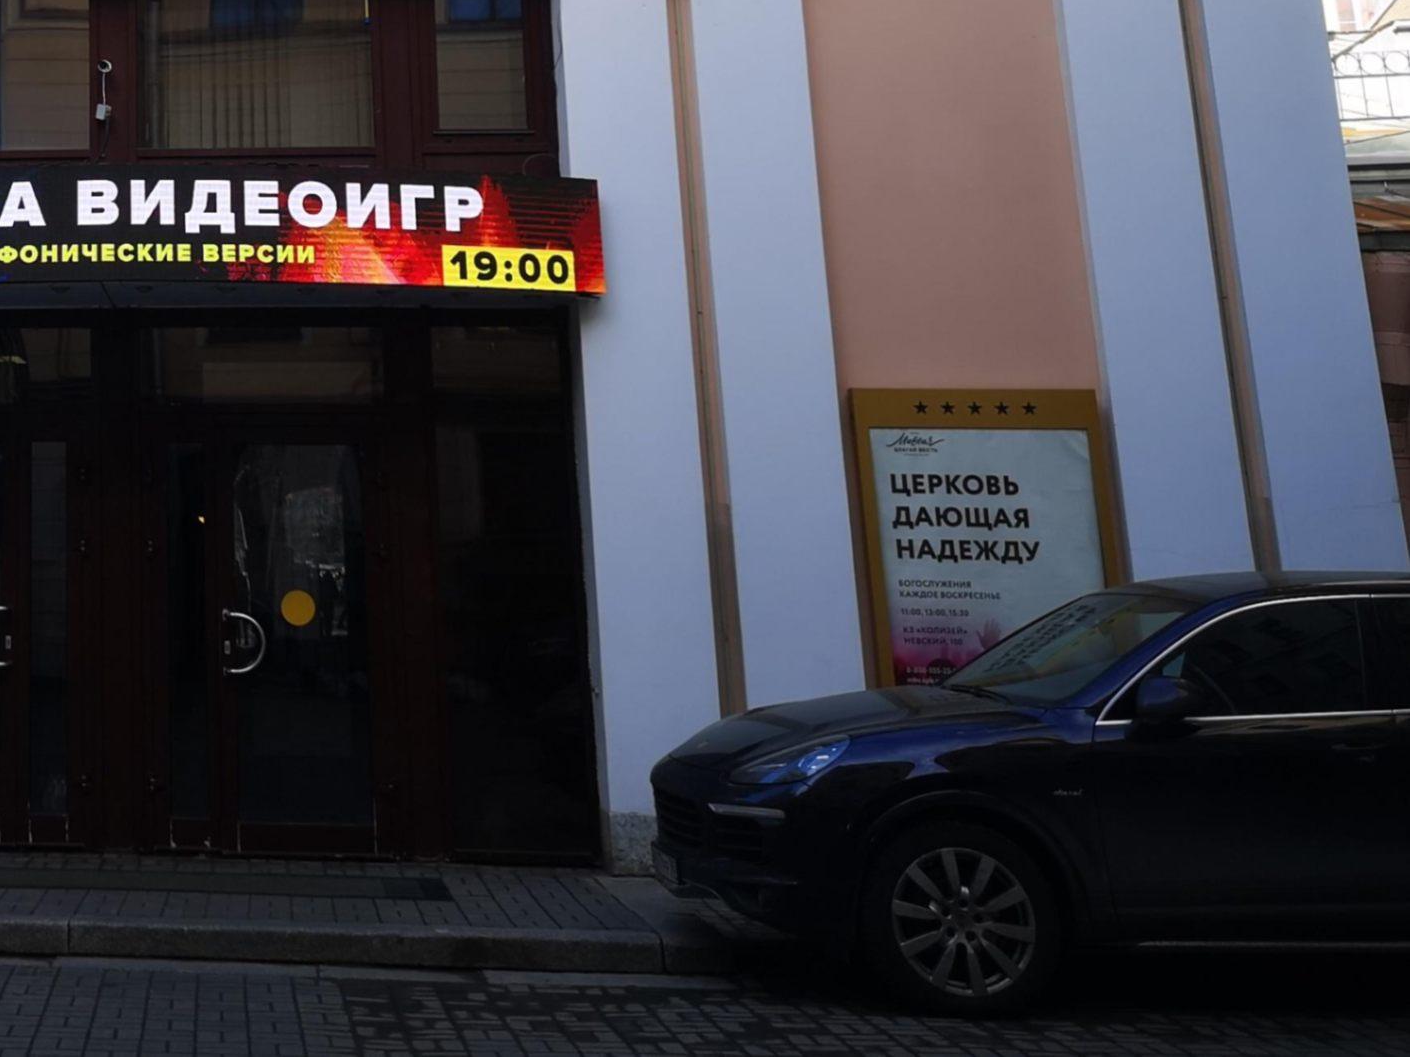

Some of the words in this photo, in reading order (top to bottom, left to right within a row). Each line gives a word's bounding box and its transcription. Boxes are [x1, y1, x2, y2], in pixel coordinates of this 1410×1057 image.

[76, 178, 485, 234] ВИДЕОИГР
[202, 242, 316, 264] ВЕРСИИ
[448, 248, 571, 286] 19:00
[890, 473, 1020, 497] ЦЕРКОВЬ
[892, 506, 1030, 531] ДАЮЩАЯ
[895, 538, 1040, 564] НАДЕЖДУ
[898, 578, 972, 589] БОГОСЛУЖЕНИЯ
[899, 590, 938, 599] КАЖДОЕ
[940, 591, 1002, 600] ВОСКРЕСЕНЬЕ
